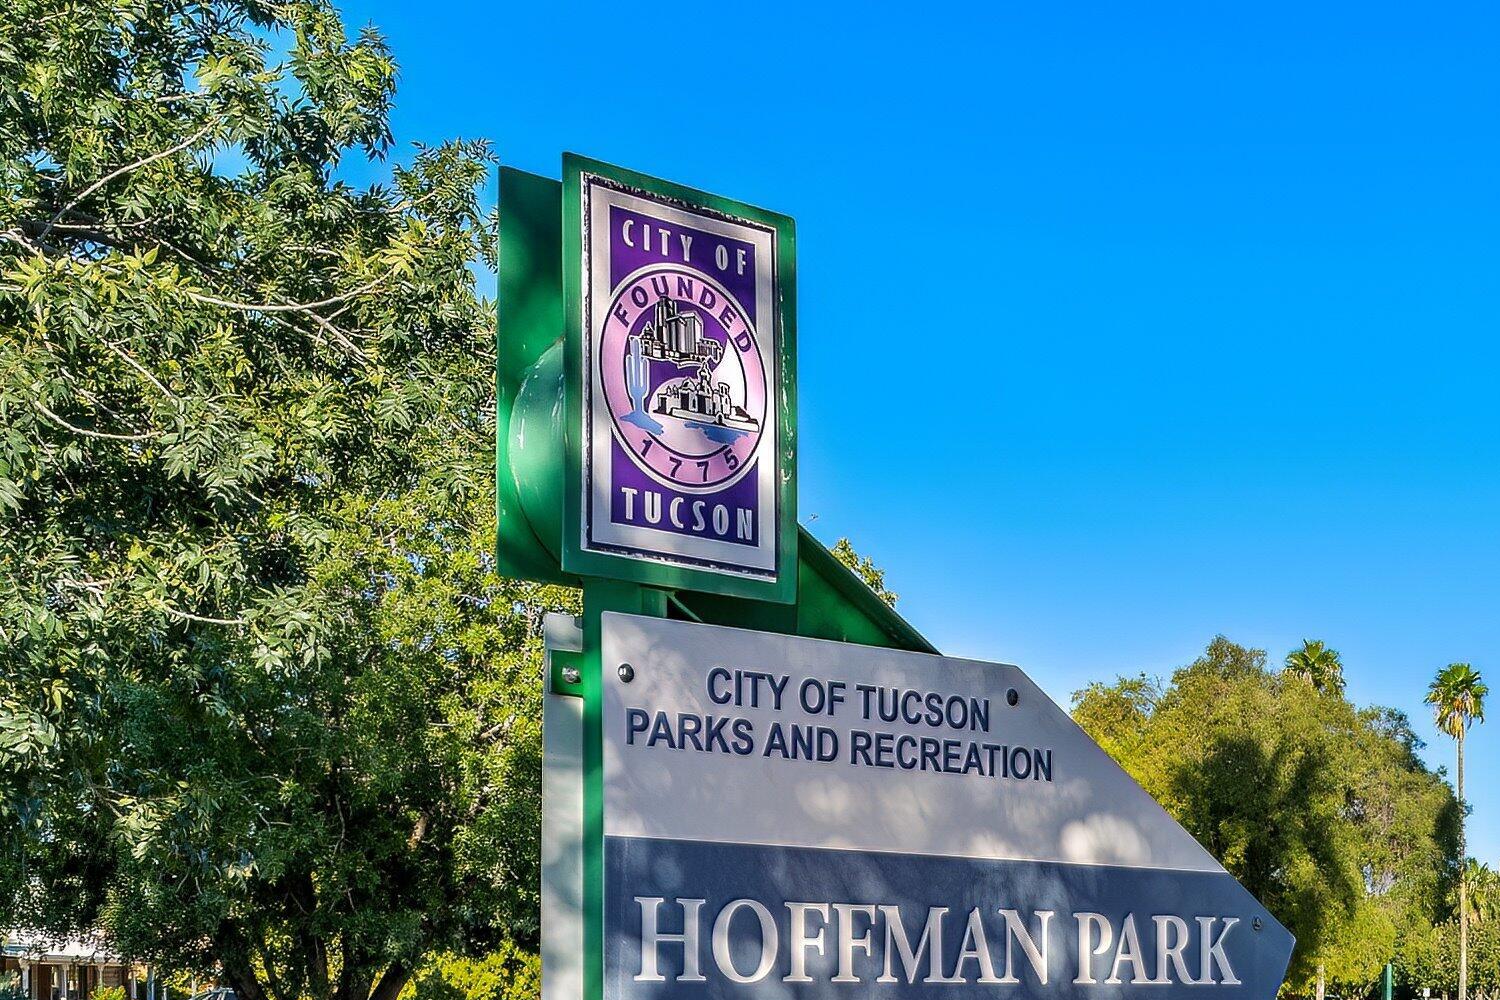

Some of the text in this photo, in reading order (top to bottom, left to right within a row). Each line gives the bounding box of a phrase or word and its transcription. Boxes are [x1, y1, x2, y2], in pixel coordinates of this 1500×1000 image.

[622, 219, 746, 276] CITY OF
[613, 275, 752, 353] FOUNDED
[640, 438, 739, 483] 1775
[621, 487, 752, 540] TUCSON
[706, 666, 989, 732] CITY OF TUCSON
[626, 707, 1053, 782] PARKS AND RECREATION
[633, 896, 1242, 985] HOFFMAN PARK
